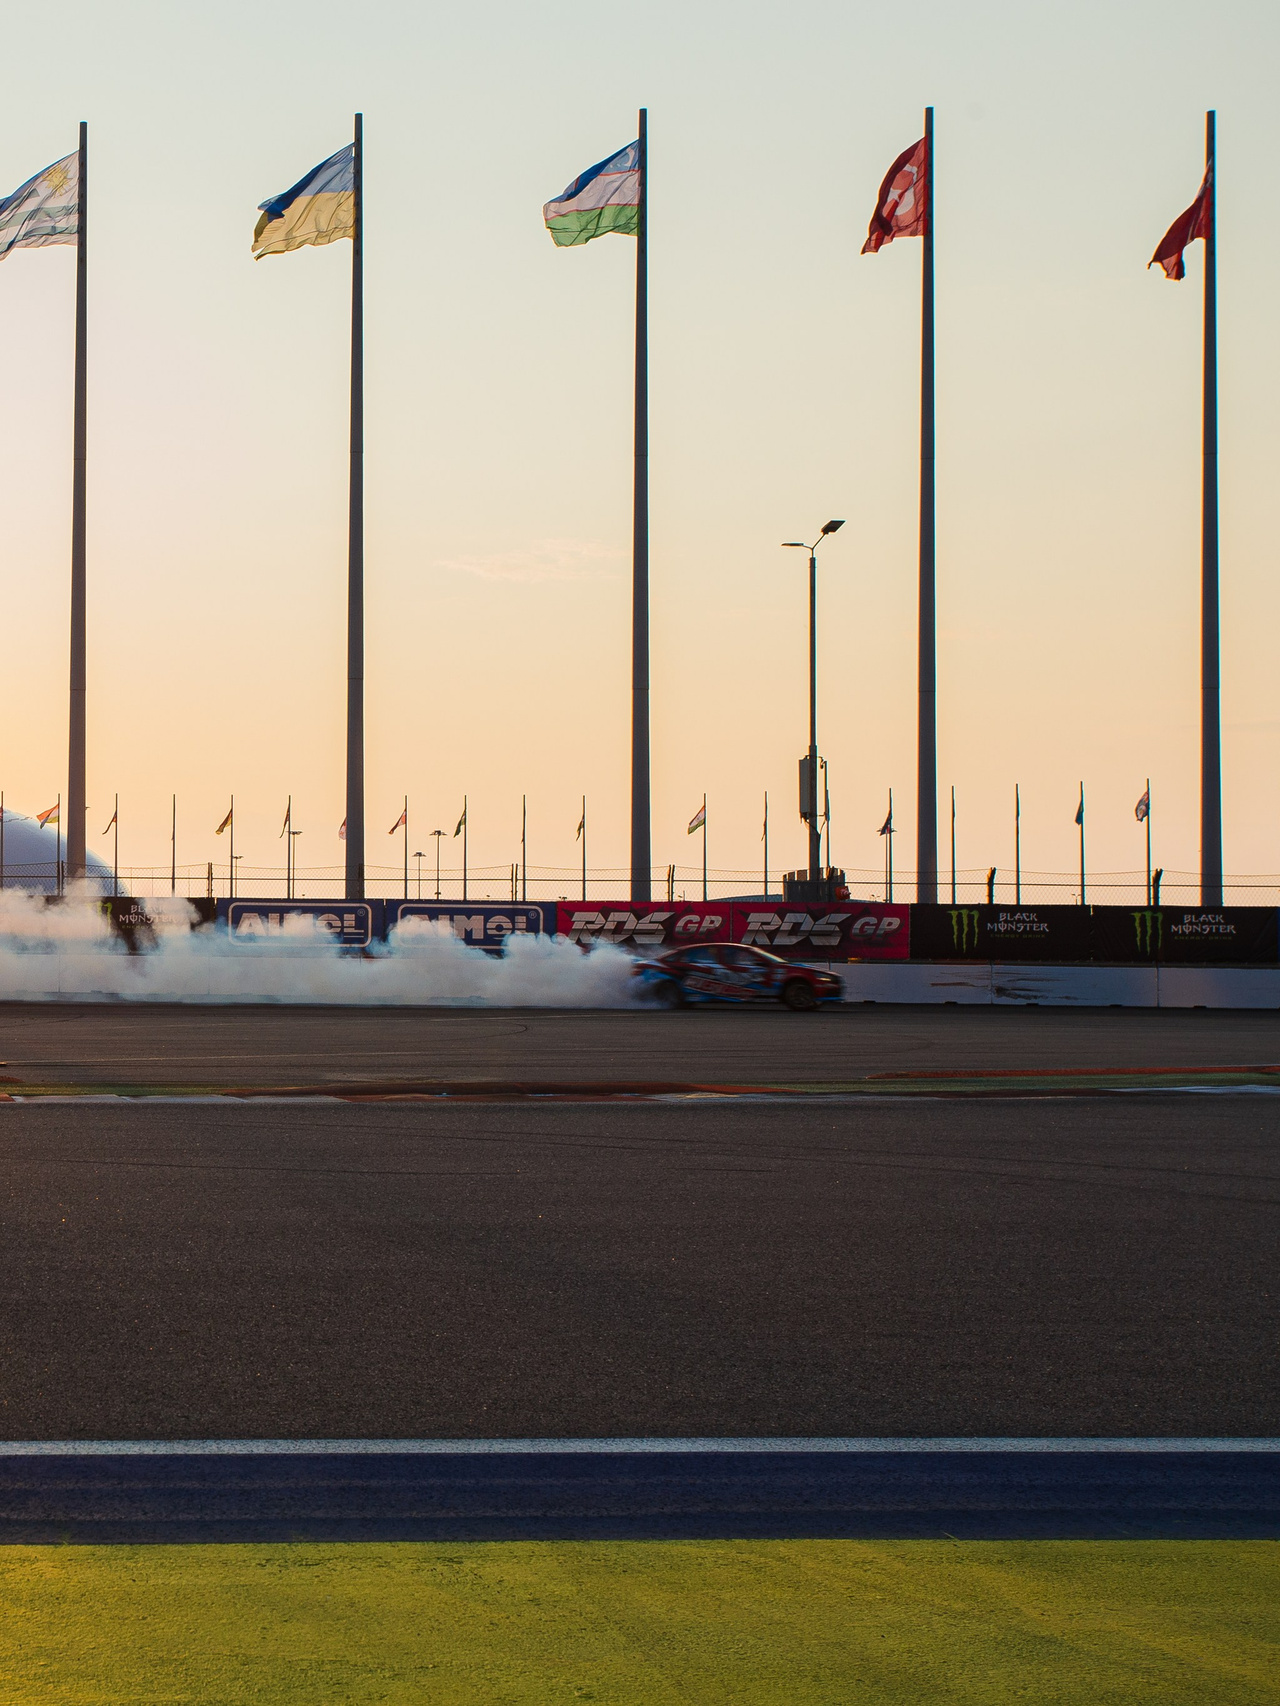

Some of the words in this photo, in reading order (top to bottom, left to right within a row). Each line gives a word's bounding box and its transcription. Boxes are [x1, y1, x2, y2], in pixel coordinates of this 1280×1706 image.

[999, 912, 1038, 922] BLACK
[1183, 914, 1225, 924] BLACK
[235, 912, 365, 938] AIMOL
[568, 911, 675, 944] RDS
[675, 914, 722, 936] GP
[740, 912, 852, 946] RDS
[852, 916, 901, 939] GP
[987, 921, 1050, 933] MONSTER
[1170, 923, 1237, 935] MONSTER
